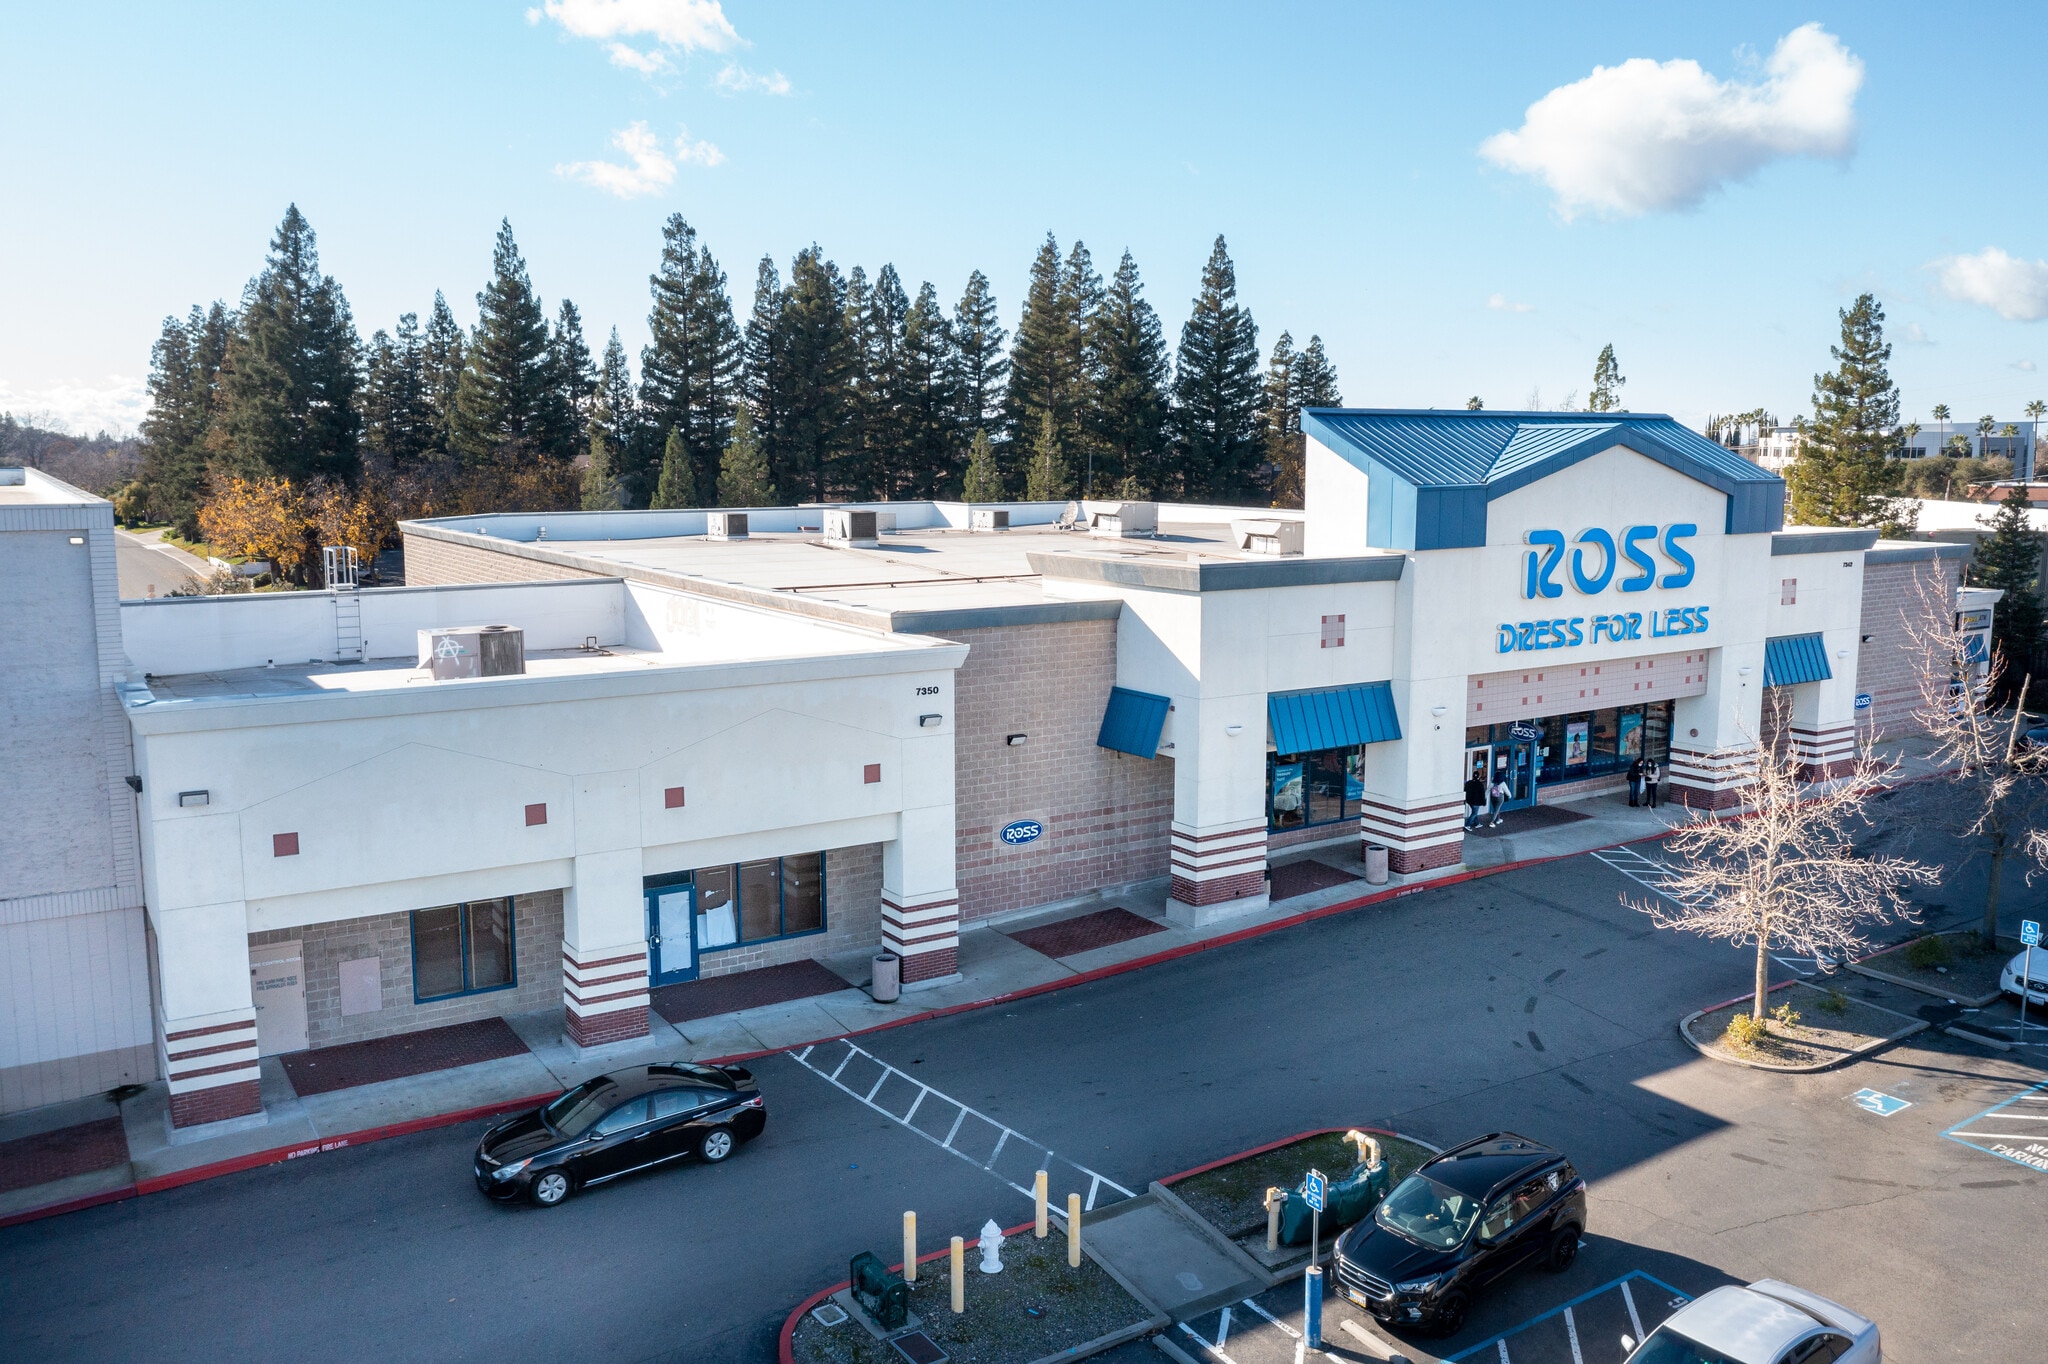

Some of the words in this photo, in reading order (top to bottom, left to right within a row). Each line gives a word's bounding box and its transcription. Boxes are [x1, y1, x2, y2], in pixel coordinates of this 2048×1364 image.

[1522, 523, 1698, 600] ROSS
[1496, 617, 1584, 653] DRESS
[1590, 612, 1643, 644] FOR
[1649, 606, 1710, 638] LESS
[915, 686, 939, 696] 7350
[1006, 824, 1039, 840] ROSS
[287, 1151, 296, 1160] NO
[1990, 1143, 2048, 1170] PARKIN
